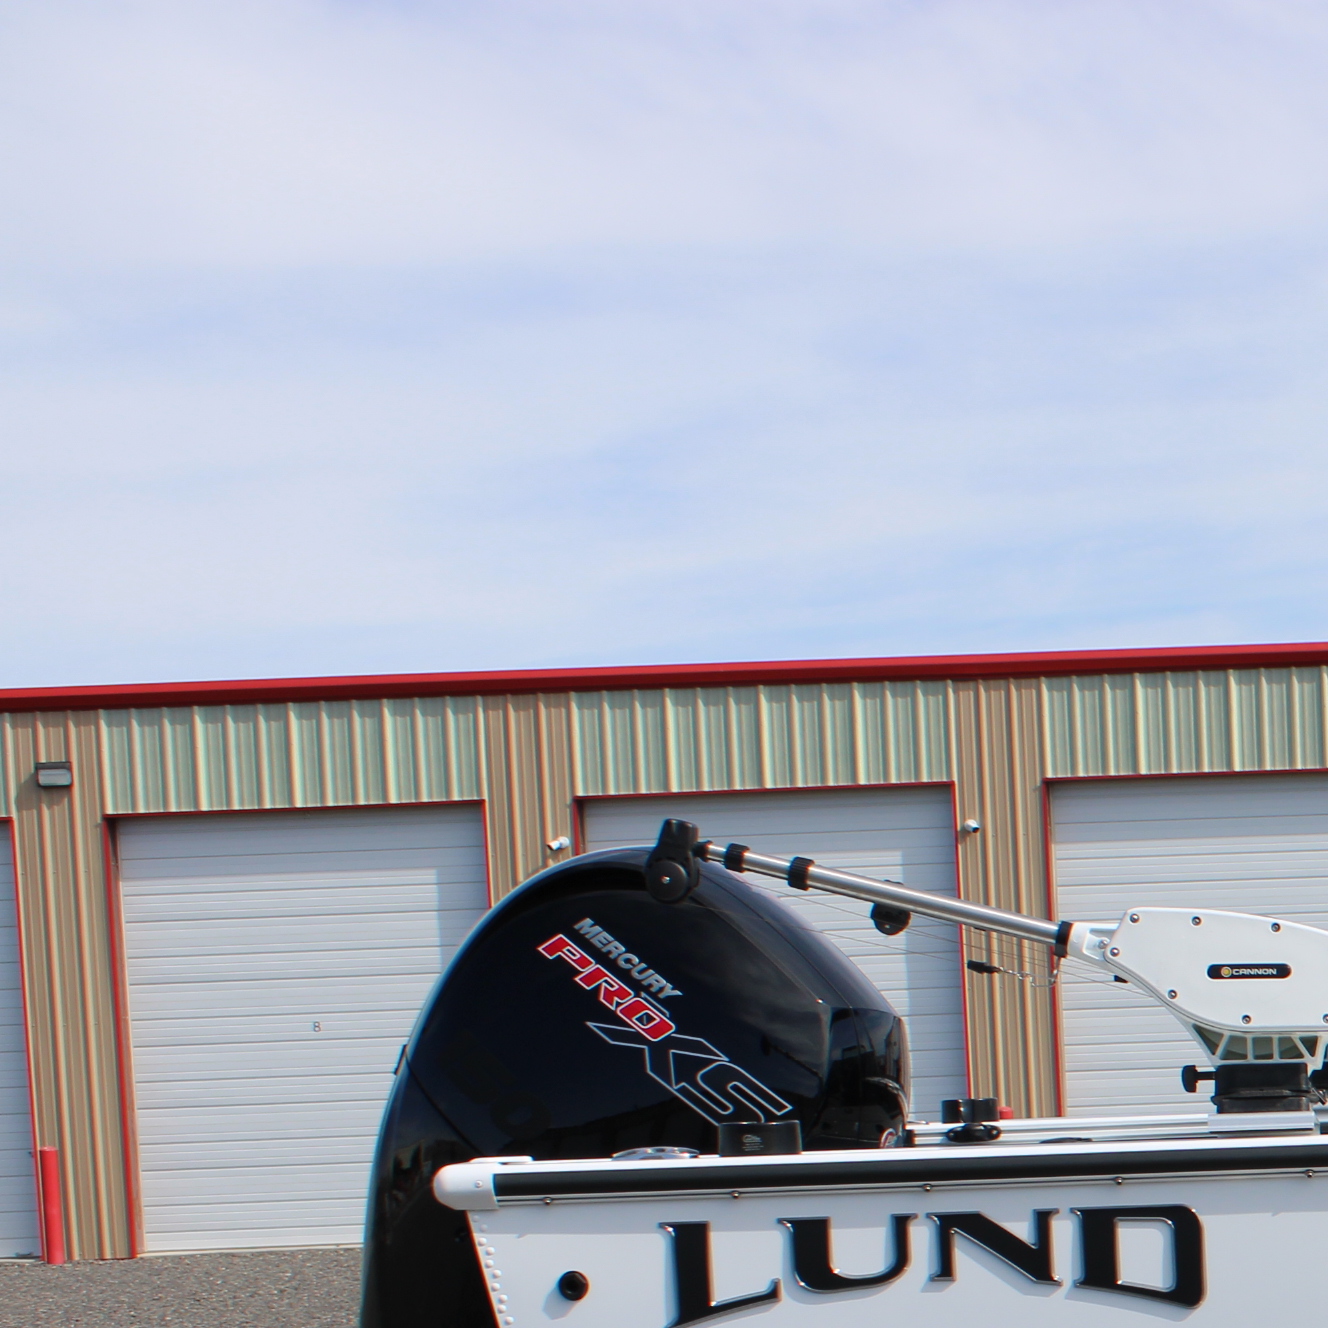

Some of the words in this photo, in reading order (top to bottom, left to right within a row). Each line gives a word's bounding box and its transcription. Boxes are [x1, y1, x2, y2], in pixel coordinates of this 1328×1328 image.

[537, 933, 676, 1042] PRO
[573, 917, 684, 1000] MERCURY
[1232, 968, 1277, 976] CANNON
[313, 1021, 321, 1032] 8
[585, 1020, 794, 1127] XS
